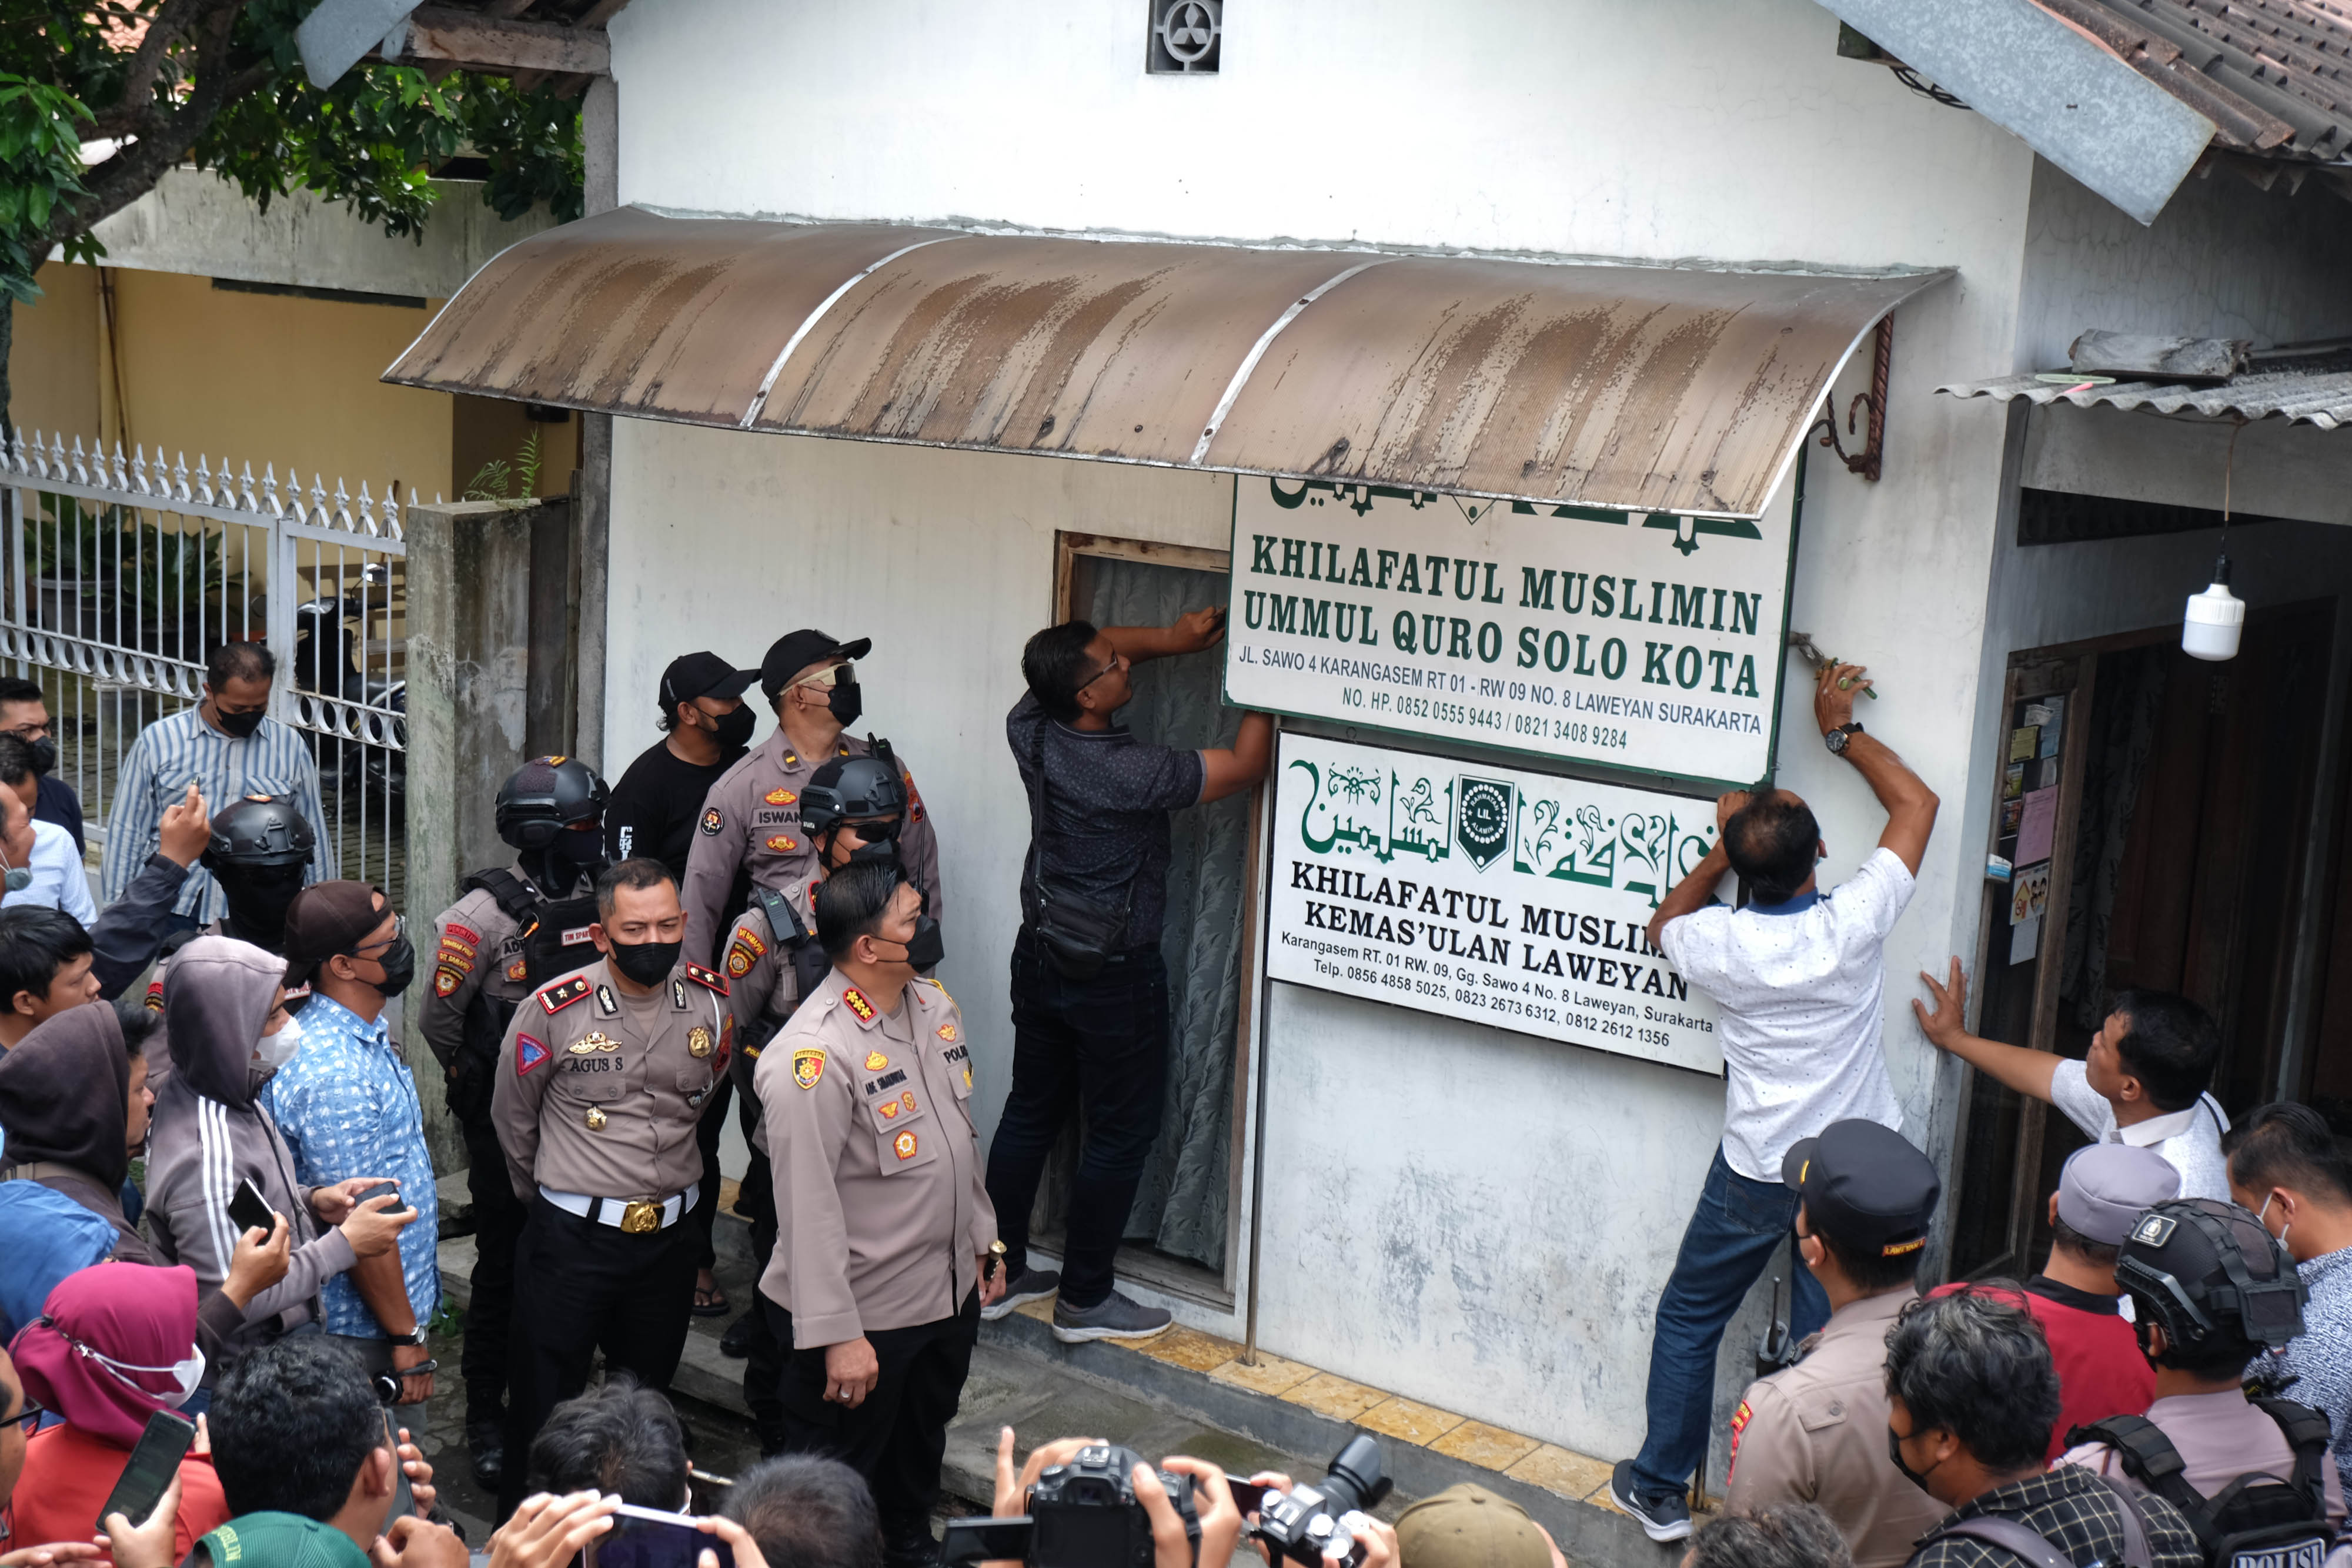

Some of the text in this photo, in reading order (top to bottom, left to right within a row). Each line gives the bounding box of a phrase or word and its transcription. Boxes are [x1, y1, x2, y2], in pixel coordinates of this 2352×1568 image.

[1250, 534, 1762, 636] KHILAFATUL MUSLIMIN
[1244, 590, 1759, 698] UMMUL QURO SOLO KOTA
[1239, 646, 1258, 664] JL.
[1262, 648, 1305, 670] SAWO
[1308, 655, 1317, 672] 4
[1321, 656, 1422, 687] KARANGASEM
[1427, 670, 1446, 690] RT
[1450, 674, 1465, 693] 01
[1480, 678, 1505, 698] RW
[1509, 681, 1526, 701] 09
[1531, 684, 1557, 706] NO.
[1562, 690, 1571, 708] 8
[1576, 692, 1653, 720] LAWEYAN
[1658, 703, 1760, 734] SURAKARTA
[1342, 687, 1626, 749] NO. HP. 0852 0555 9443 / 0821 3408 9284
[1470, 793, 1500, 811] RAHMATAN
[1471, 821, 1494, 834] ALAMIN
[1476, 808, 1492, 820] LIL
[1291, 860, 1509, 929] KHILAFATUL
[1282, 931, 1713, 1033] Karangasem RT. 01 RW. 09, Gg. Sawo 4 No. 8 Laweyan, Surakarta
[1304, 900, 1688, 1002] KEMAS'ULAN LAWEYAN
[1314, 958, 1669, 1047] Telp. 0856 4858 5025, 0823 2673 6312, 0812 2612 1356
[569, 1057, 623, 1073] AGUS S
